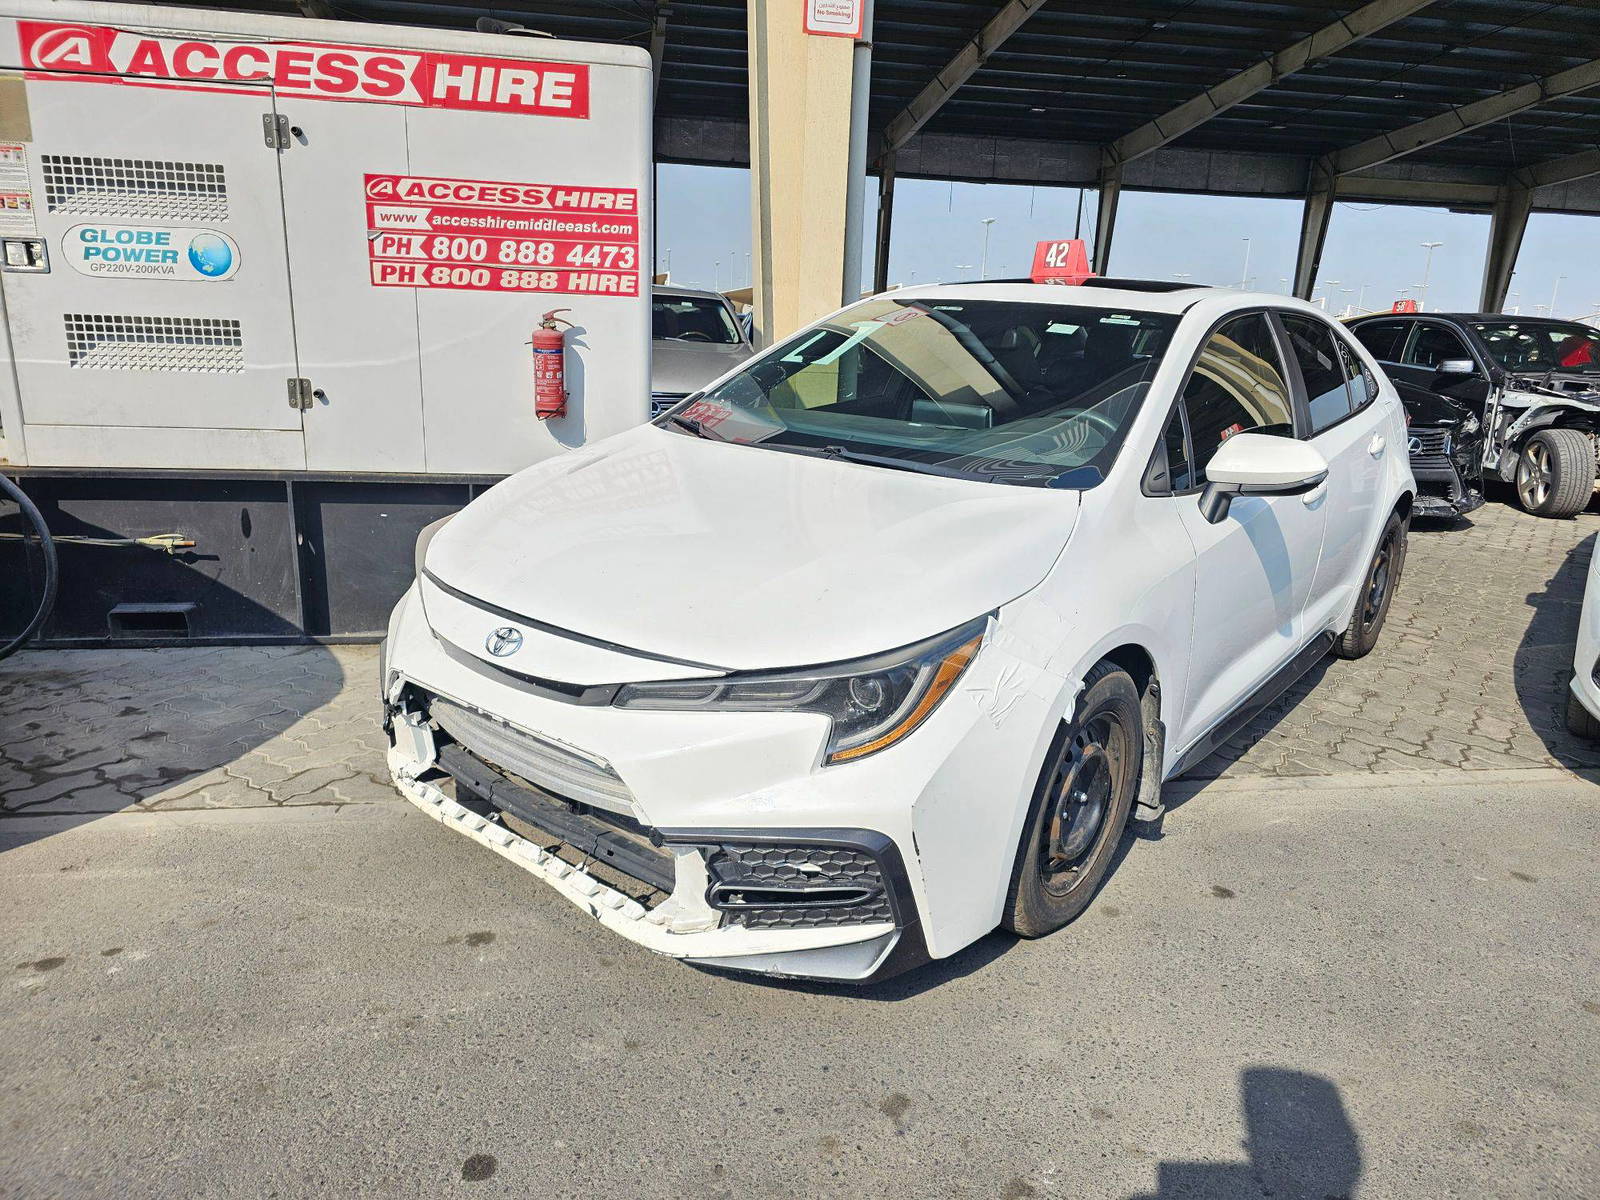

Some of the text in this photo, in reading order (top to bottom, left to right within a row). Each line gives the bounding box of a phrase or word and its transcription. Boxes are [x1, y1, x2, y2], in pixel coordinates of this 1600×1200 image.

[826, 10, 850, 18] Smoking
[126, 39, 406, 97] ACCESS
[432, 63, 576, 109] HIRE
[403, 182, 545, 206] ACCESS
[554, 191, 636, 210] HIRE
[380, 212, 633, 235] www accesshiremiddleeast.com
[79, 228, 172, 246] GLOBE
[83, 246, 179, 264] POWER
[381, 236, 635, 269] PH 800 888 4473
[1046, 242, 1069, 267] 42
[90, 262, 176, 276] GP220V-200KVA
[380, 264, 637, 293] PH 800 888 HIRE
